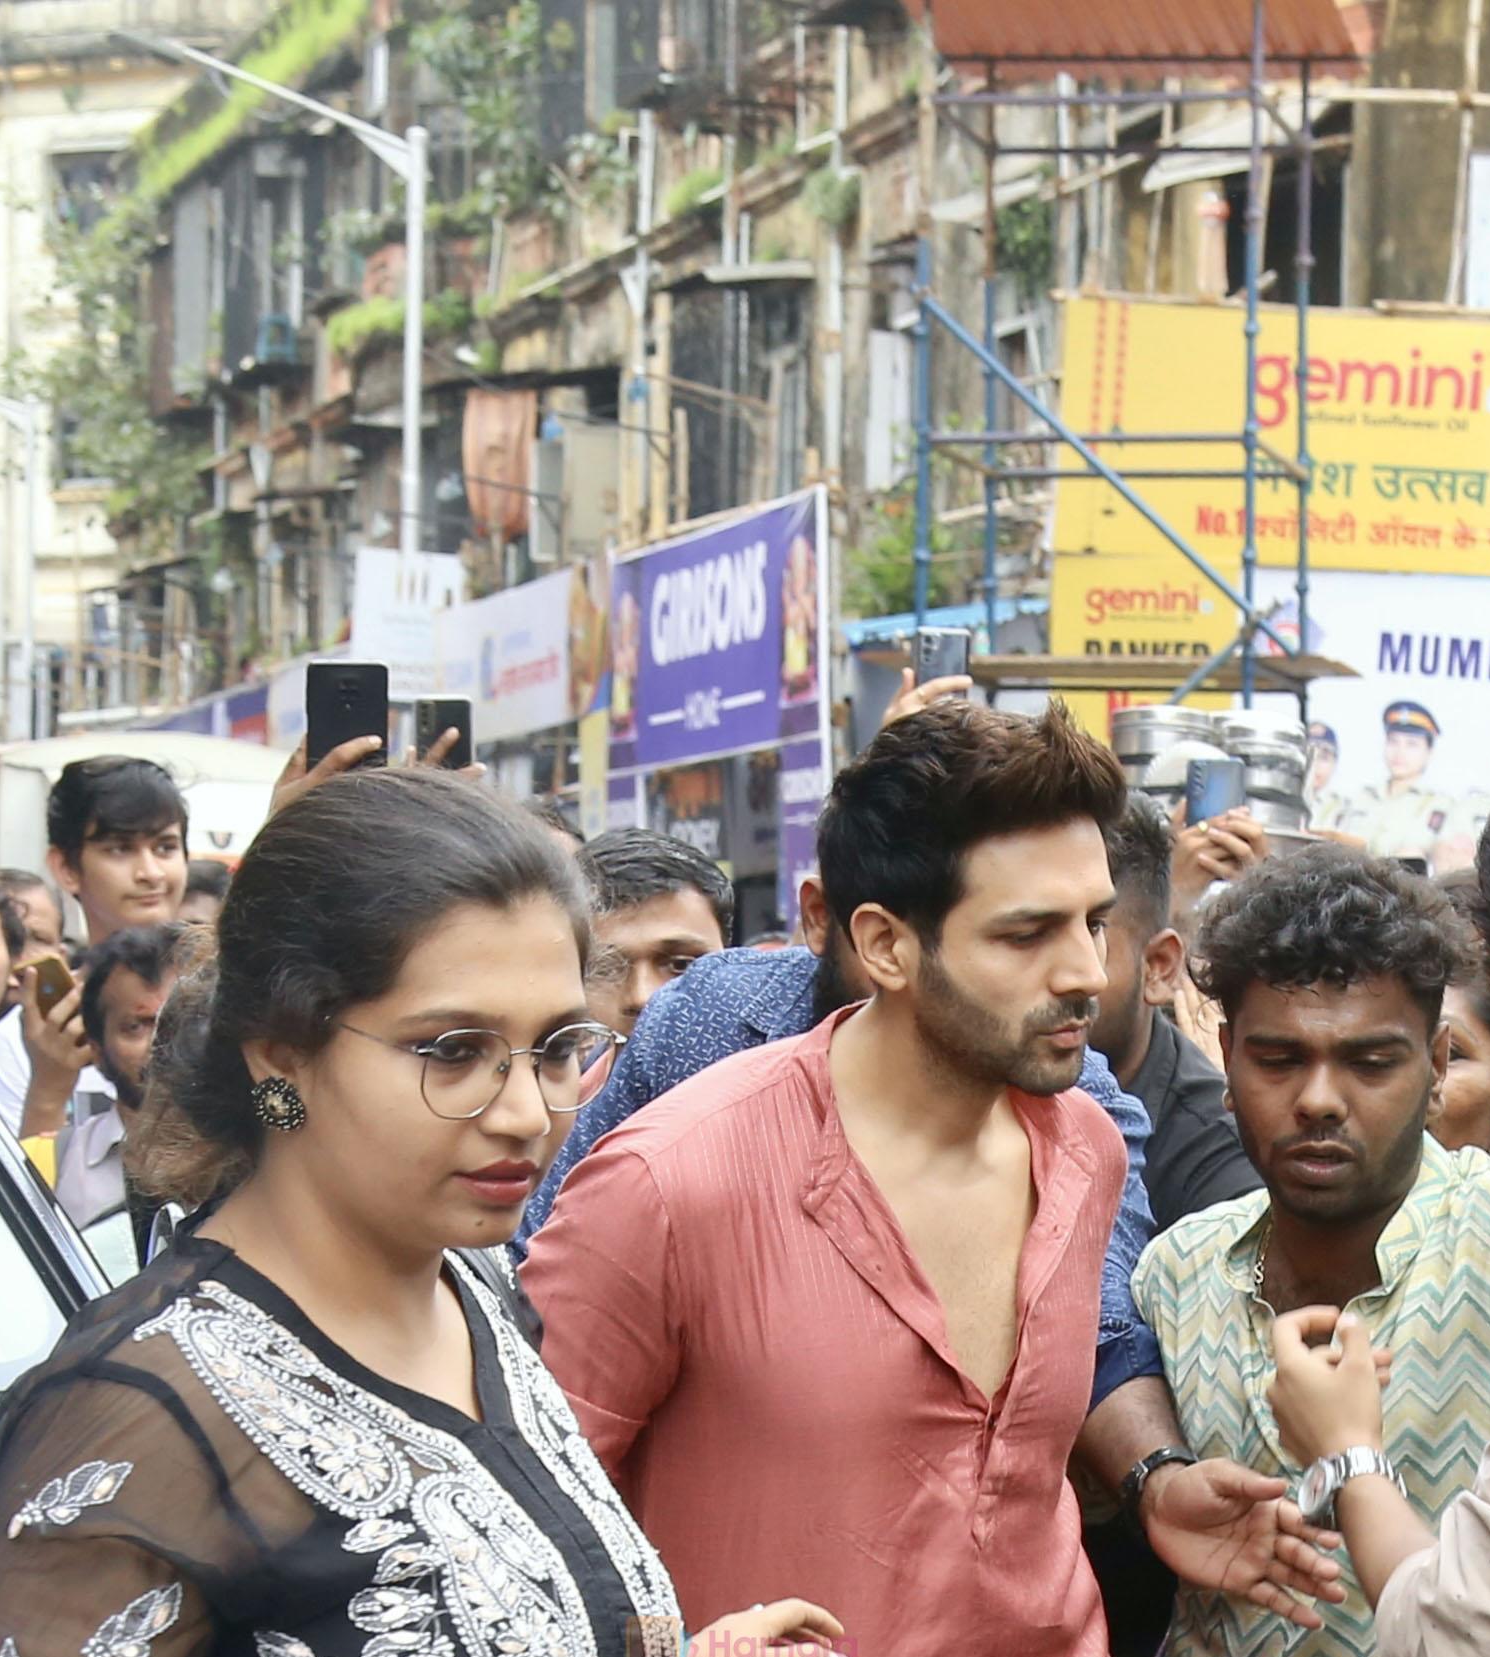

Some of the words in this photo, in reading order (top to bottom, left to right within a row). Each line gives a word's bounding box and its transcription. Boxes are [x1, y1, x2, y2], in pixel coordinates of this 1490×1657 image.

[1254, 347, 1484, 428] gemini
[1371, 464, 1490, 505] उत्सव
[650, 540, 767, 666] GIRISONS
[1085, 578, 1200, 625] gemini
